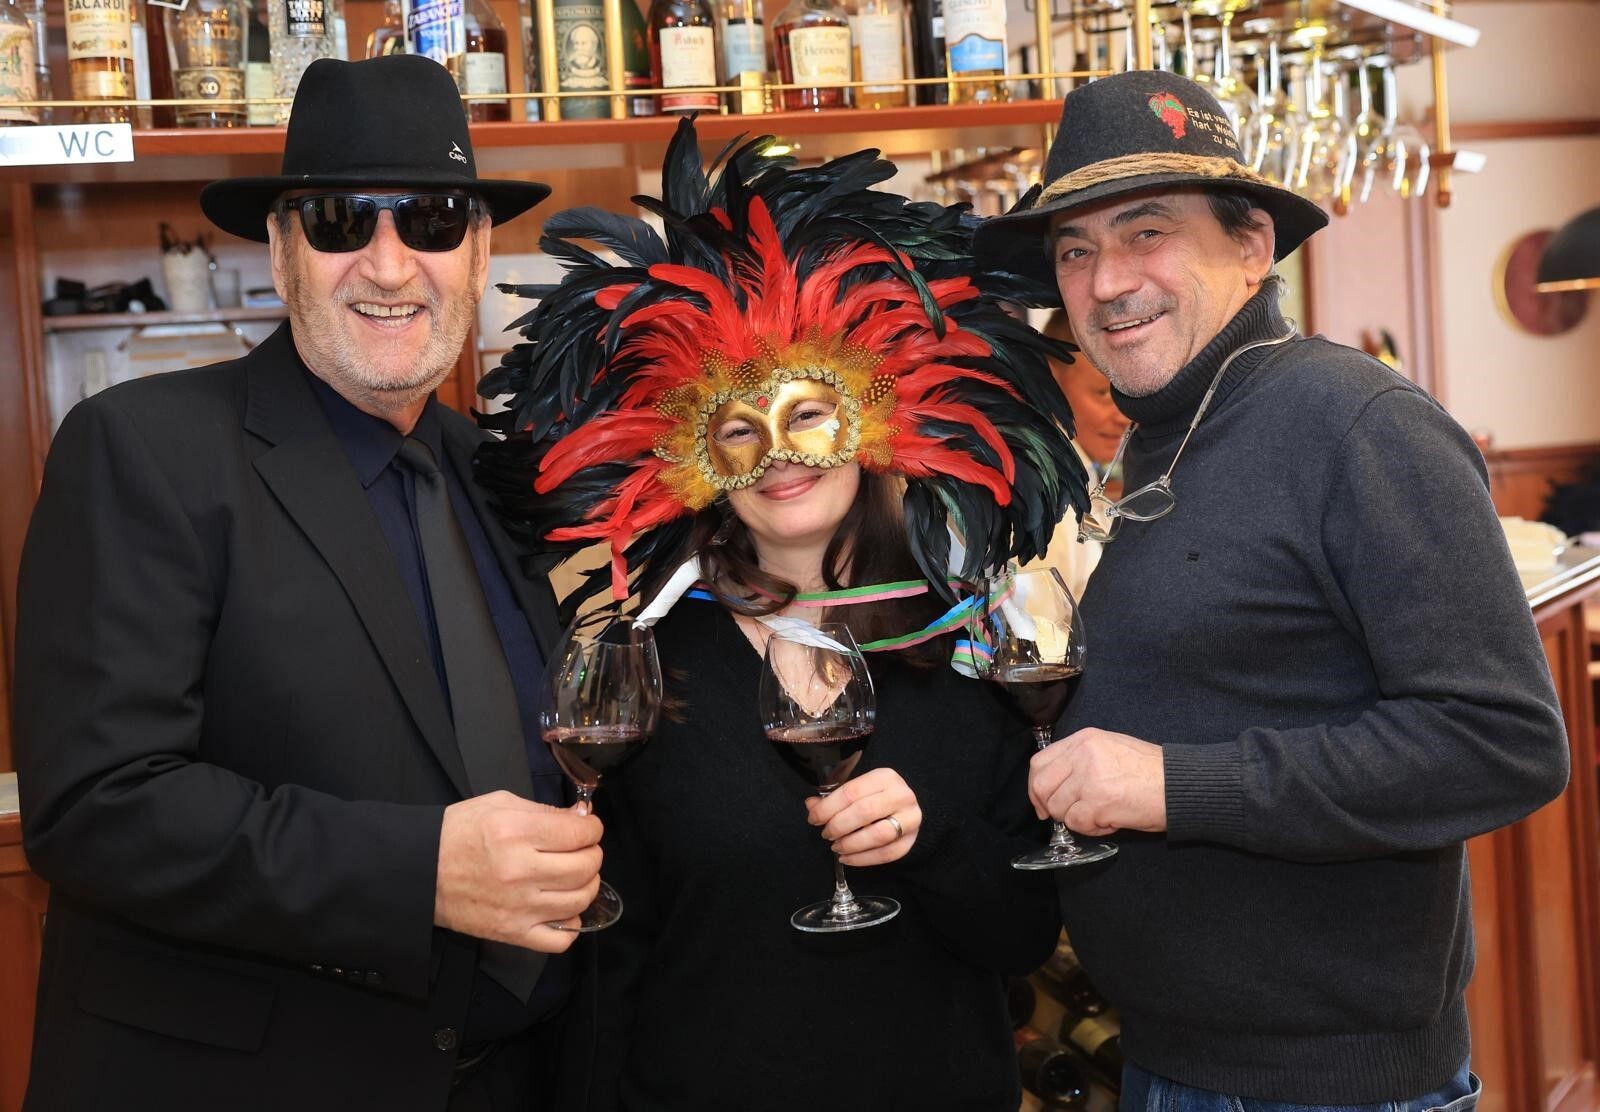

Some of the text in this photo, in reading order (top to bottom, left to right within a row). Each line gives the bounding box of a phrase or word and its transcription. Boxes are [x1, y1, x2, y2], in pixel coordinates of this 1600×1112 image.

[199, 81, 219, 95] XO
[1187, 107, 1200, 118] Es
[1200, 110, 1214, 121] ist
[58, 130, 115, 158] WC
